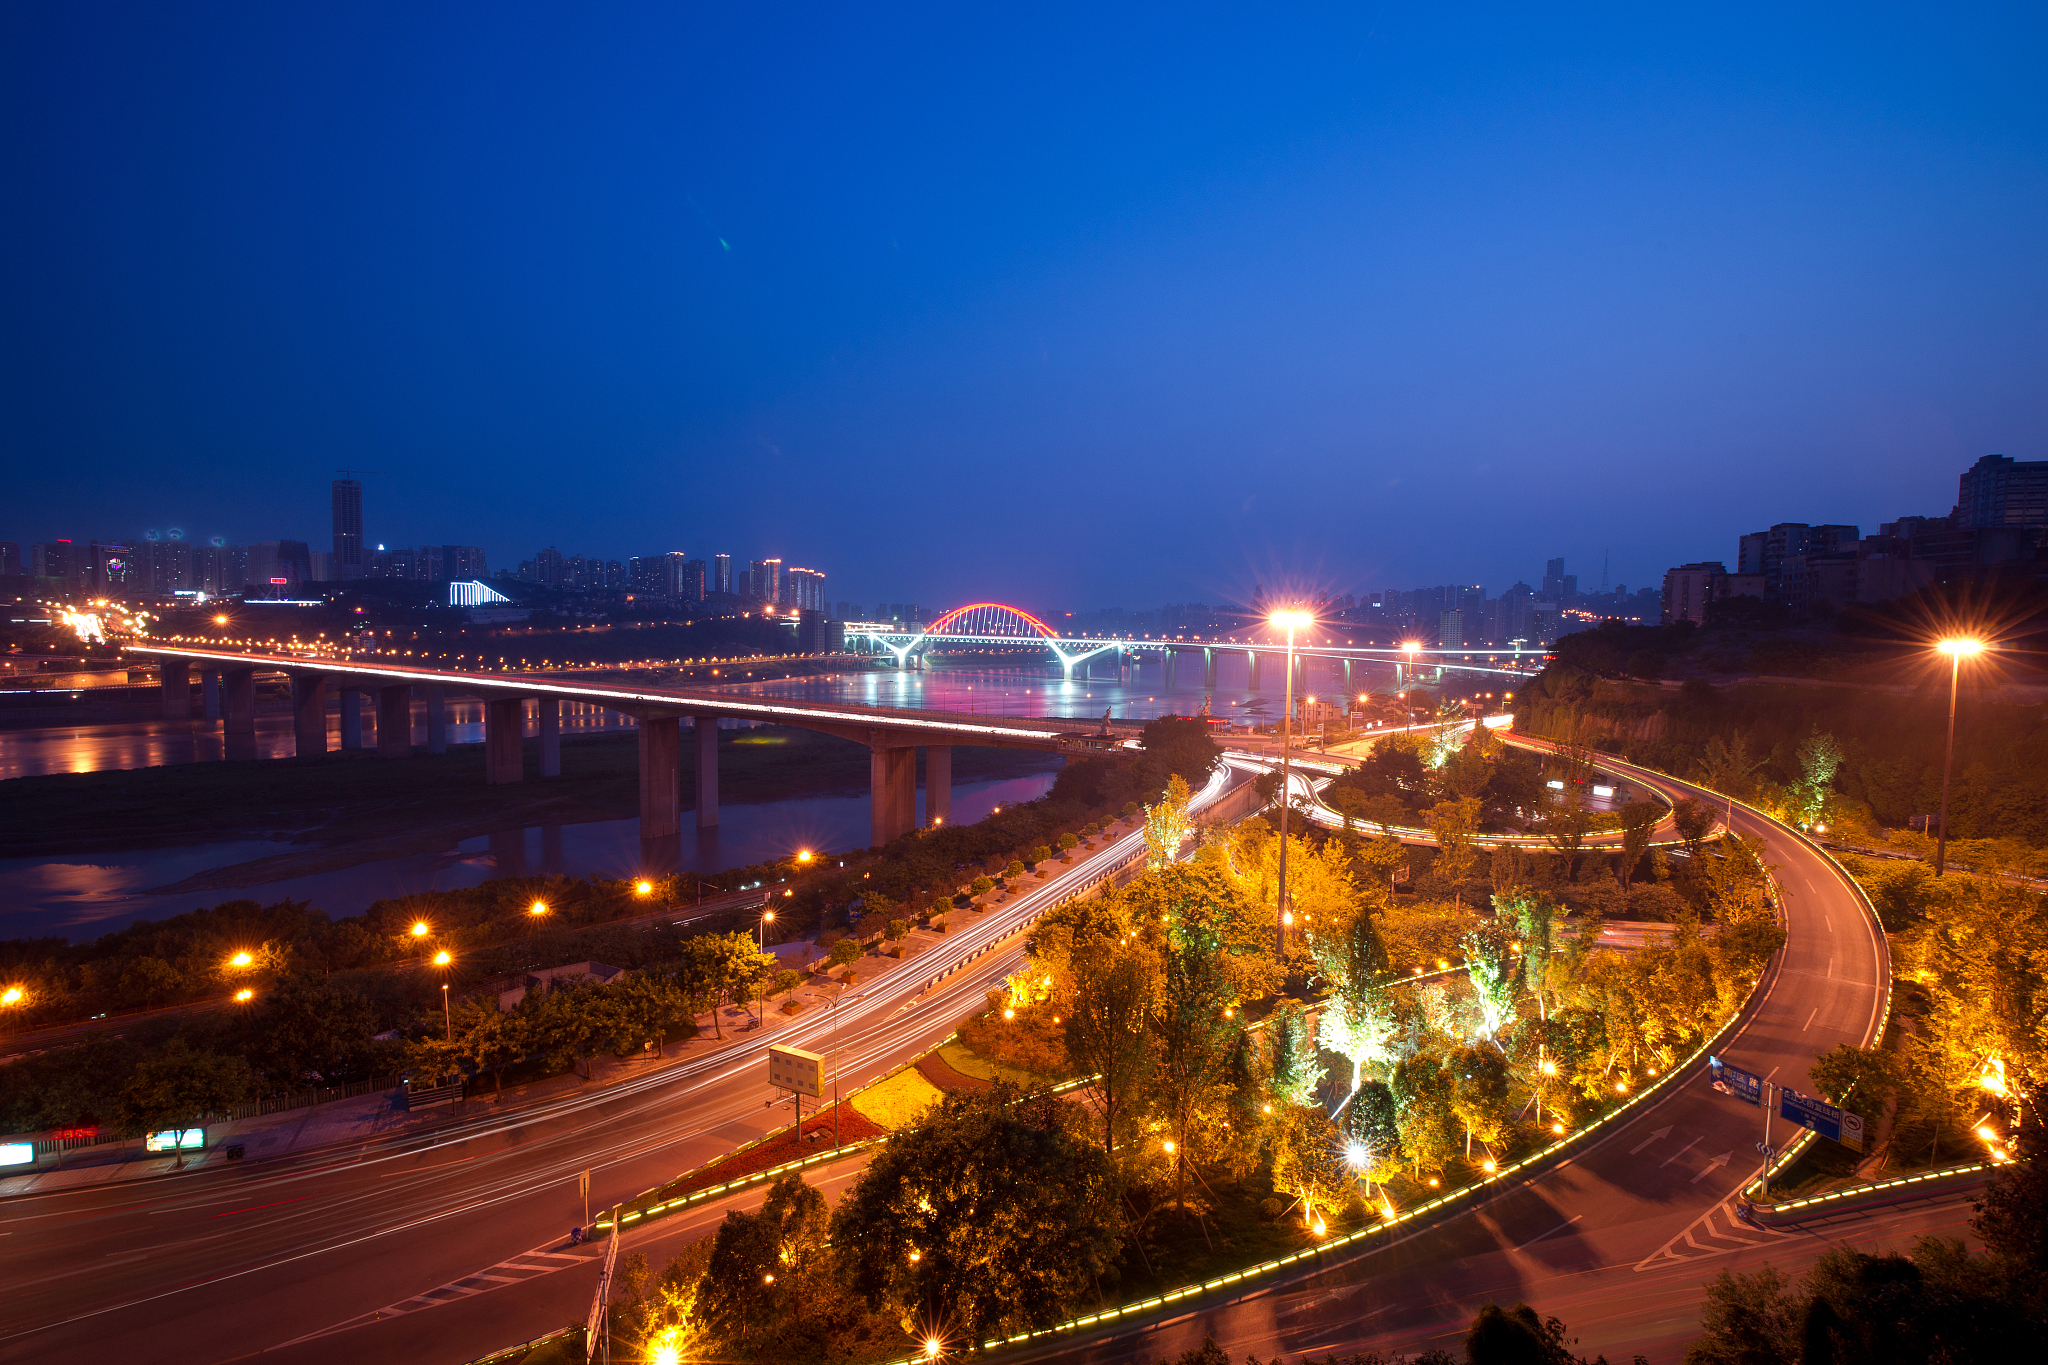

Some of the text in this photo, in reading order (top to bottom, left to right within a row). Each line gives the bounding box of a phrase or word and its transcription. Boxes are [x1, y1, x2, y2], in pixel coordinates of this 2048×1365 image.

[1723, 1067, 1760, 1090] 南区路
[1723, 1077, 1747, 1091] NANQU
[1783, 1090, 1840, 1120] 长江大桥复线桥
